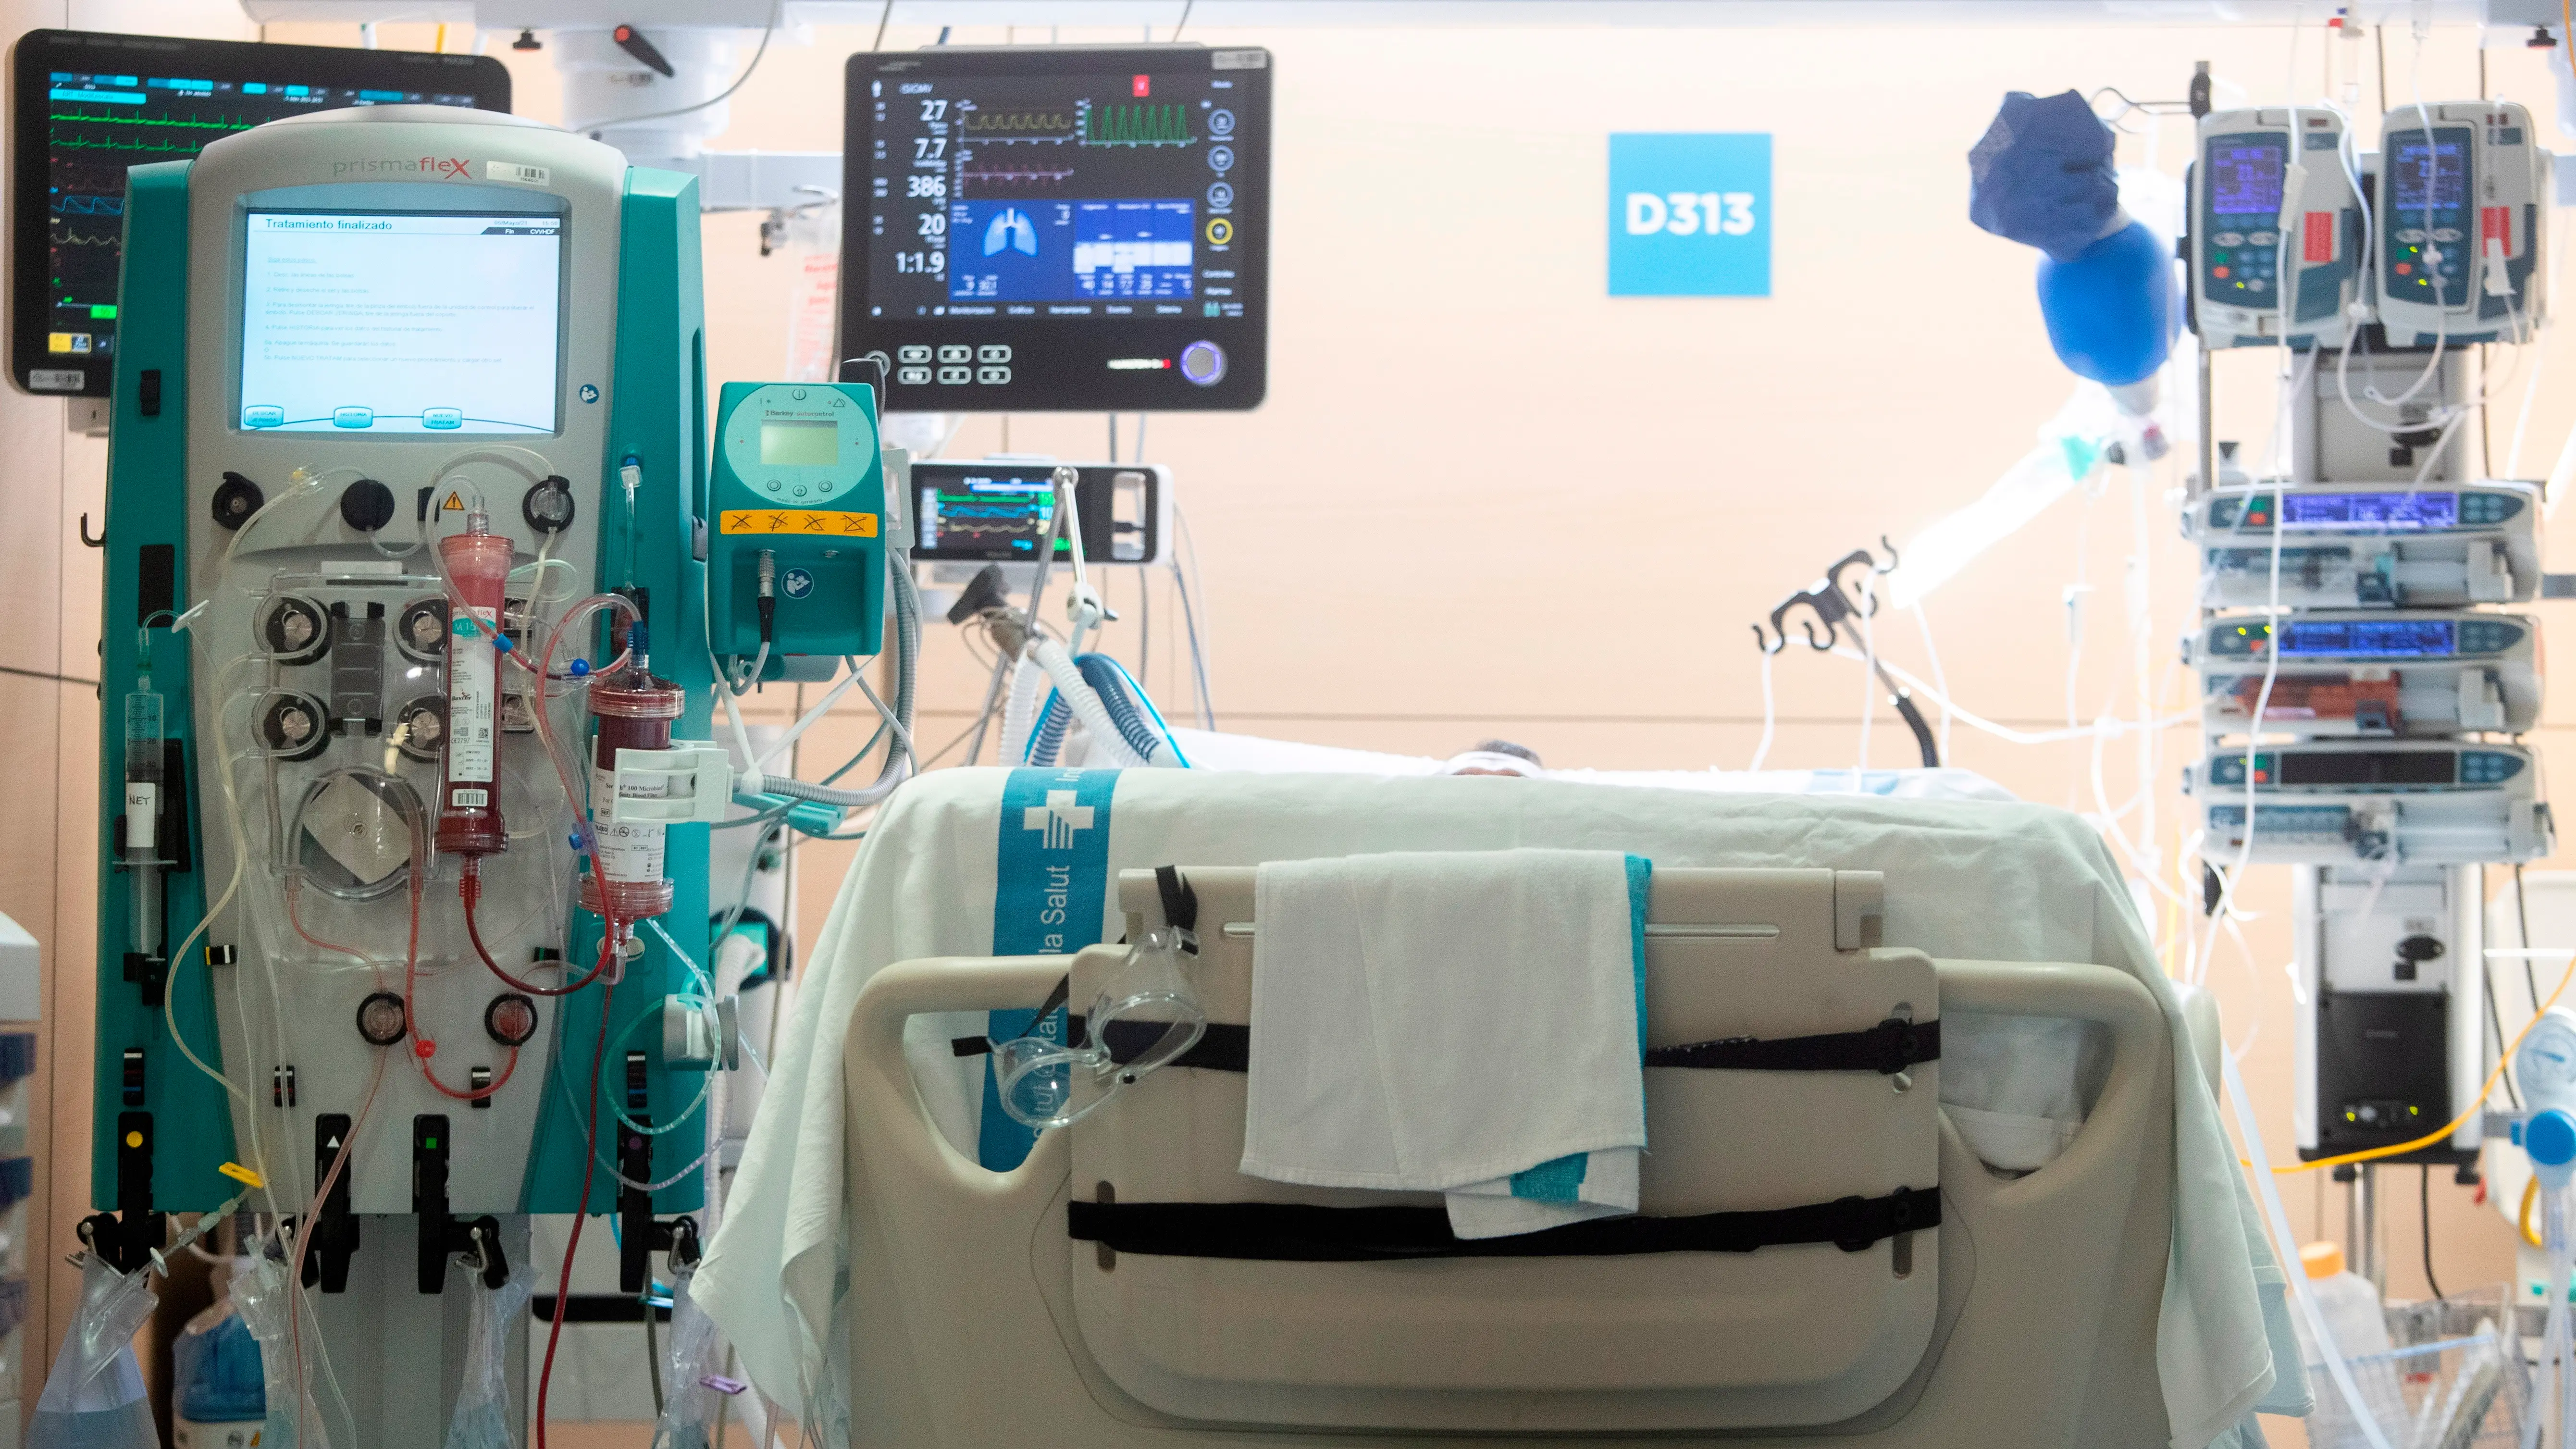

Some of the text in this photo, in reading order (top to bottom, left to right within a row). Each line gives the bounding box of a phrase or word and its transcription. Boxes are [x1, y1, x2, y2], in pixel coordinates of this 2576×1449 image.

[920, 99, 948, 121] 27
[914, 137, 948, 159] 7.7
[334, 156, 472, 179] prismaflex
[906, 175, 946, 198] 386
[265, 219, 392, 230] Tratamiento finalizado
[918, 213, 946, 235] 20
[1626, 192, 1756, 235] D313
[895, 251, 945, 273] 1:1.9
[1040, 865, 1070, 925] Salut
